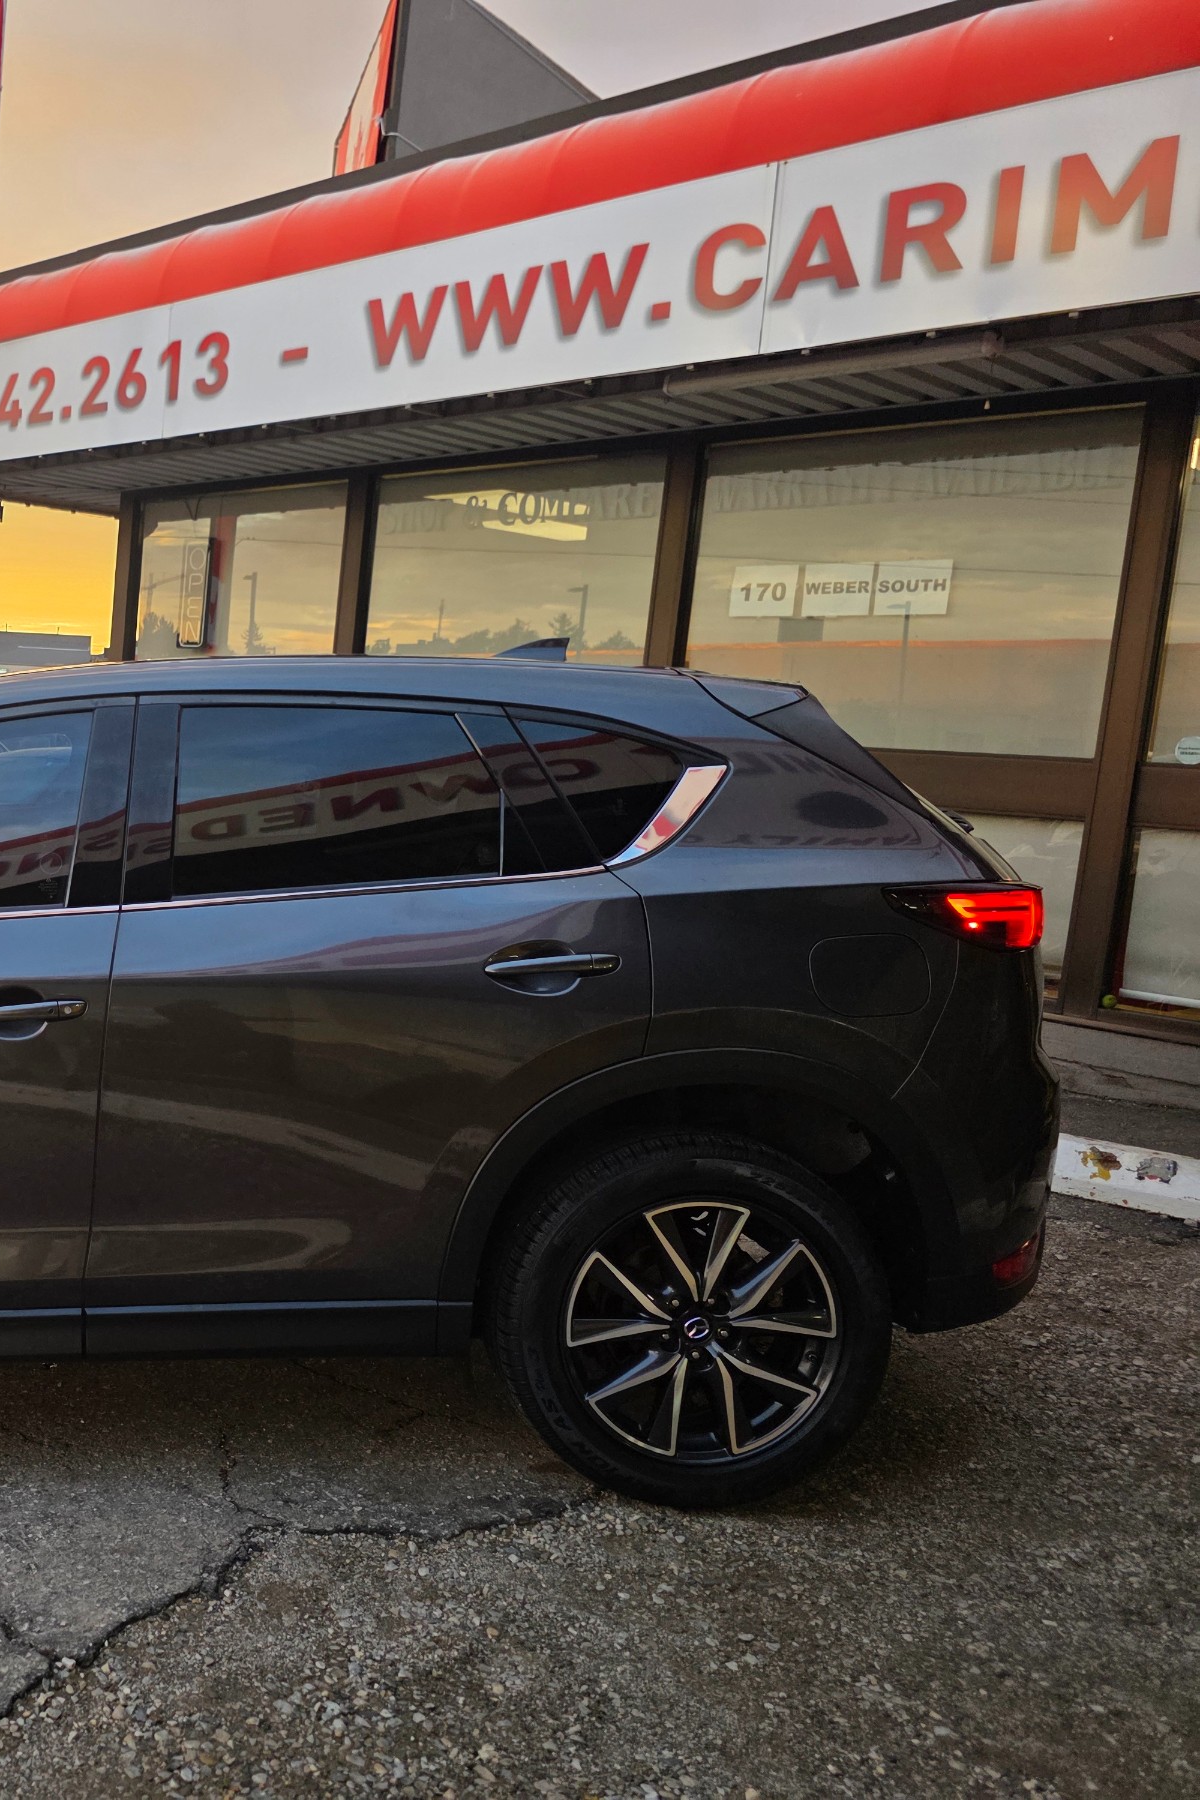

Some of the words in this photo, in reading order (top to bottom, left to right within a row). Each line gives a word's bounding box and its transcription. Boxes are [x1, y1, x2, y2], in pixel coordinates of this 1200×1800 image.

[367, 135, 1181, 367] WWW.CARIM
[185, 547, 206, 641] OPEN
[739, 581, 787, 603] 170
[804, 580, 870, 596] WEBER
[877, 577, 948, 595] SOUTH
